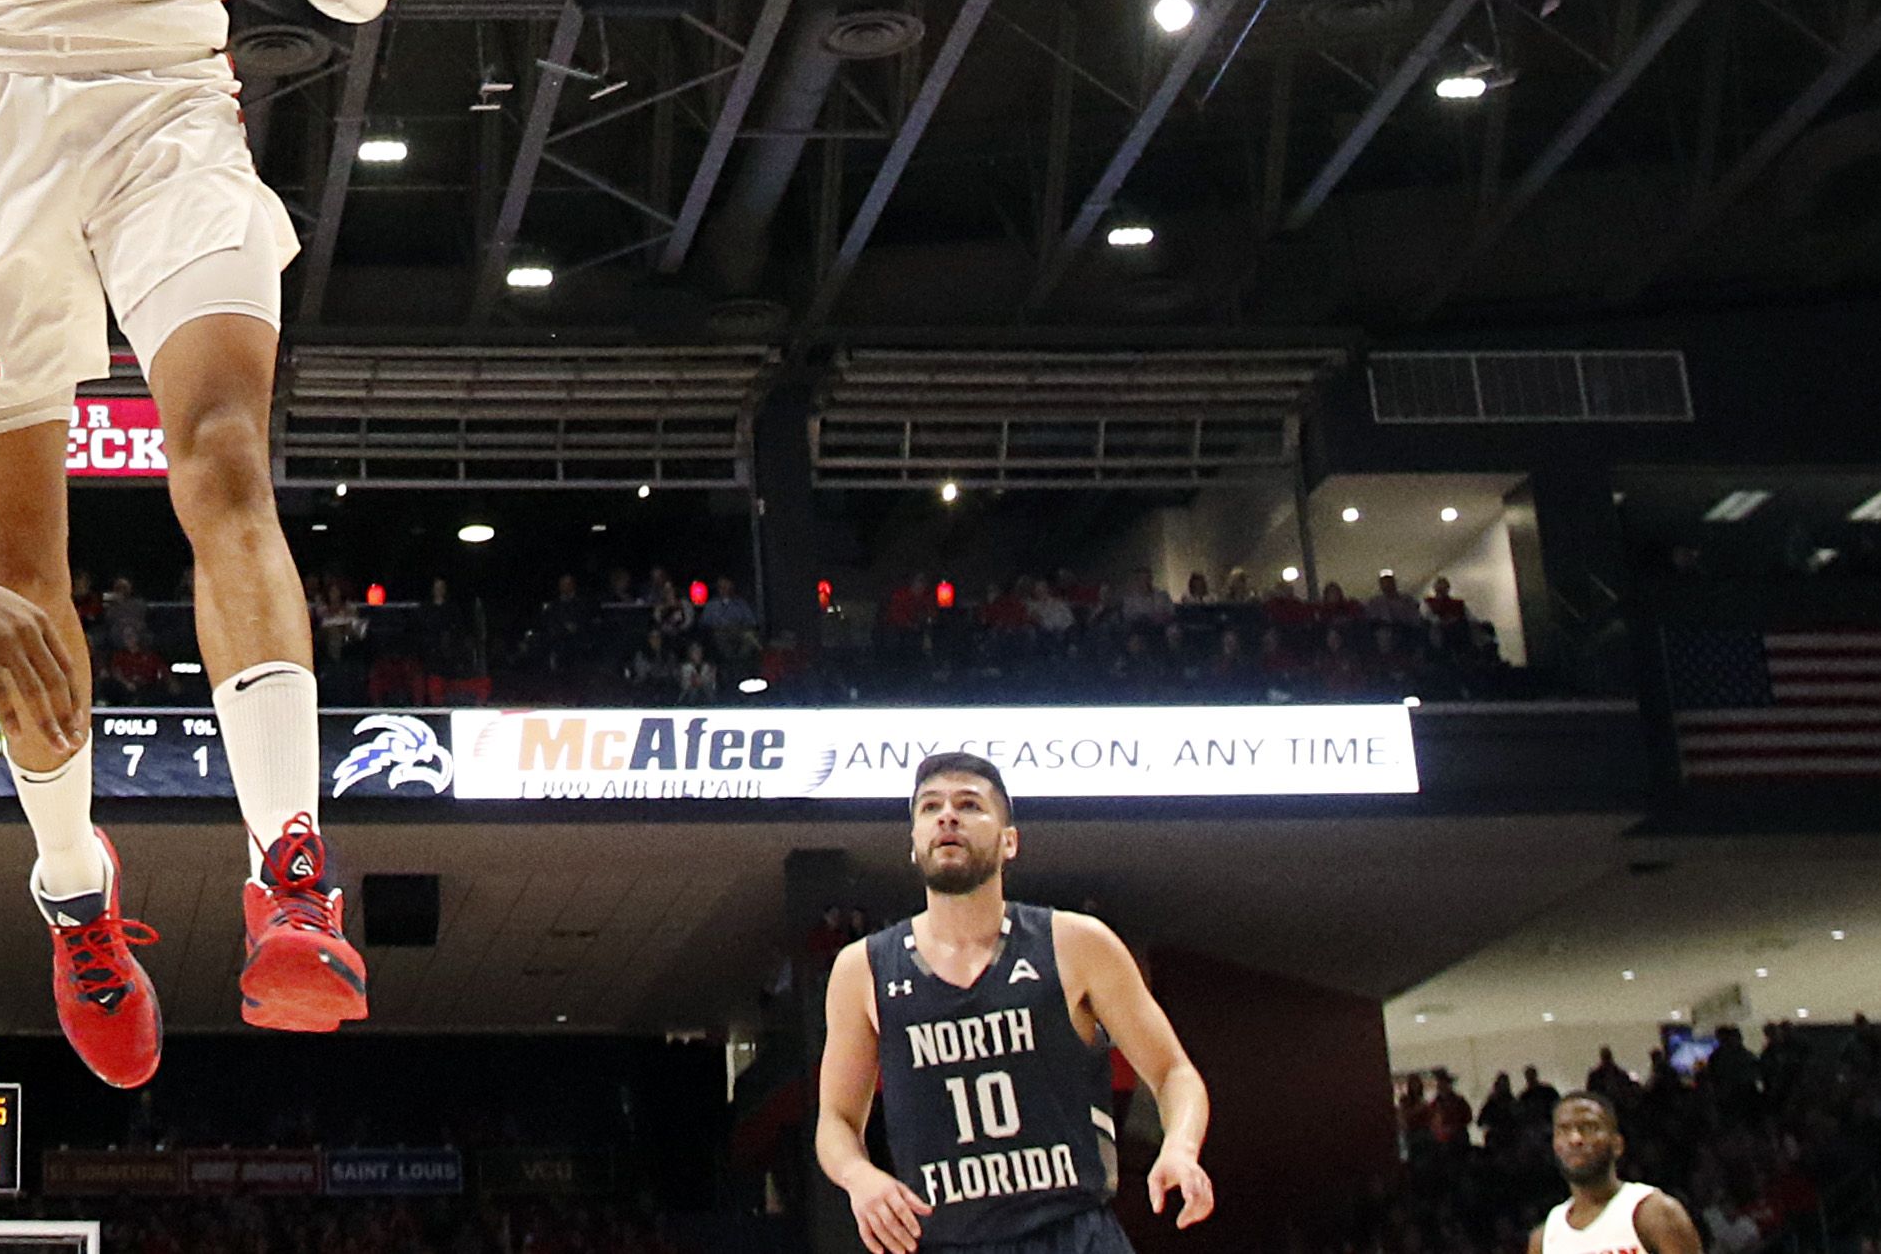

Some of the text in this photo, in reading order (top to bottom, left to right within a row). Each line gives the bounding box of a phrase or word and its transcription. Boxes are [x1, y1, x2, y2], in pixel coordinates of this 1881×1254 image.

[65, 427, 169, 470] ECK
[104, 718, 158, 737] FOULS
[182, 718, 218, 737] TOL
[518, 716, 786, 771] McAfee
[122, 744, 145, 778] 7
[192, 744, 209, 778] 1
[845, 739, 943, 770] ANY
[959, 738, 1152, 773] SEASON,
[1173, 737, 1265, 767] ANY
[905, 1007, 1037, 1069] NORTH
[945, 1070, 1021, 1145] 10
[331, 1161, 389, 1182] SAINT
[399, 1161, 457, 1182] LOUIS
[920, 1143, 1079, 1207] FLORIDA
